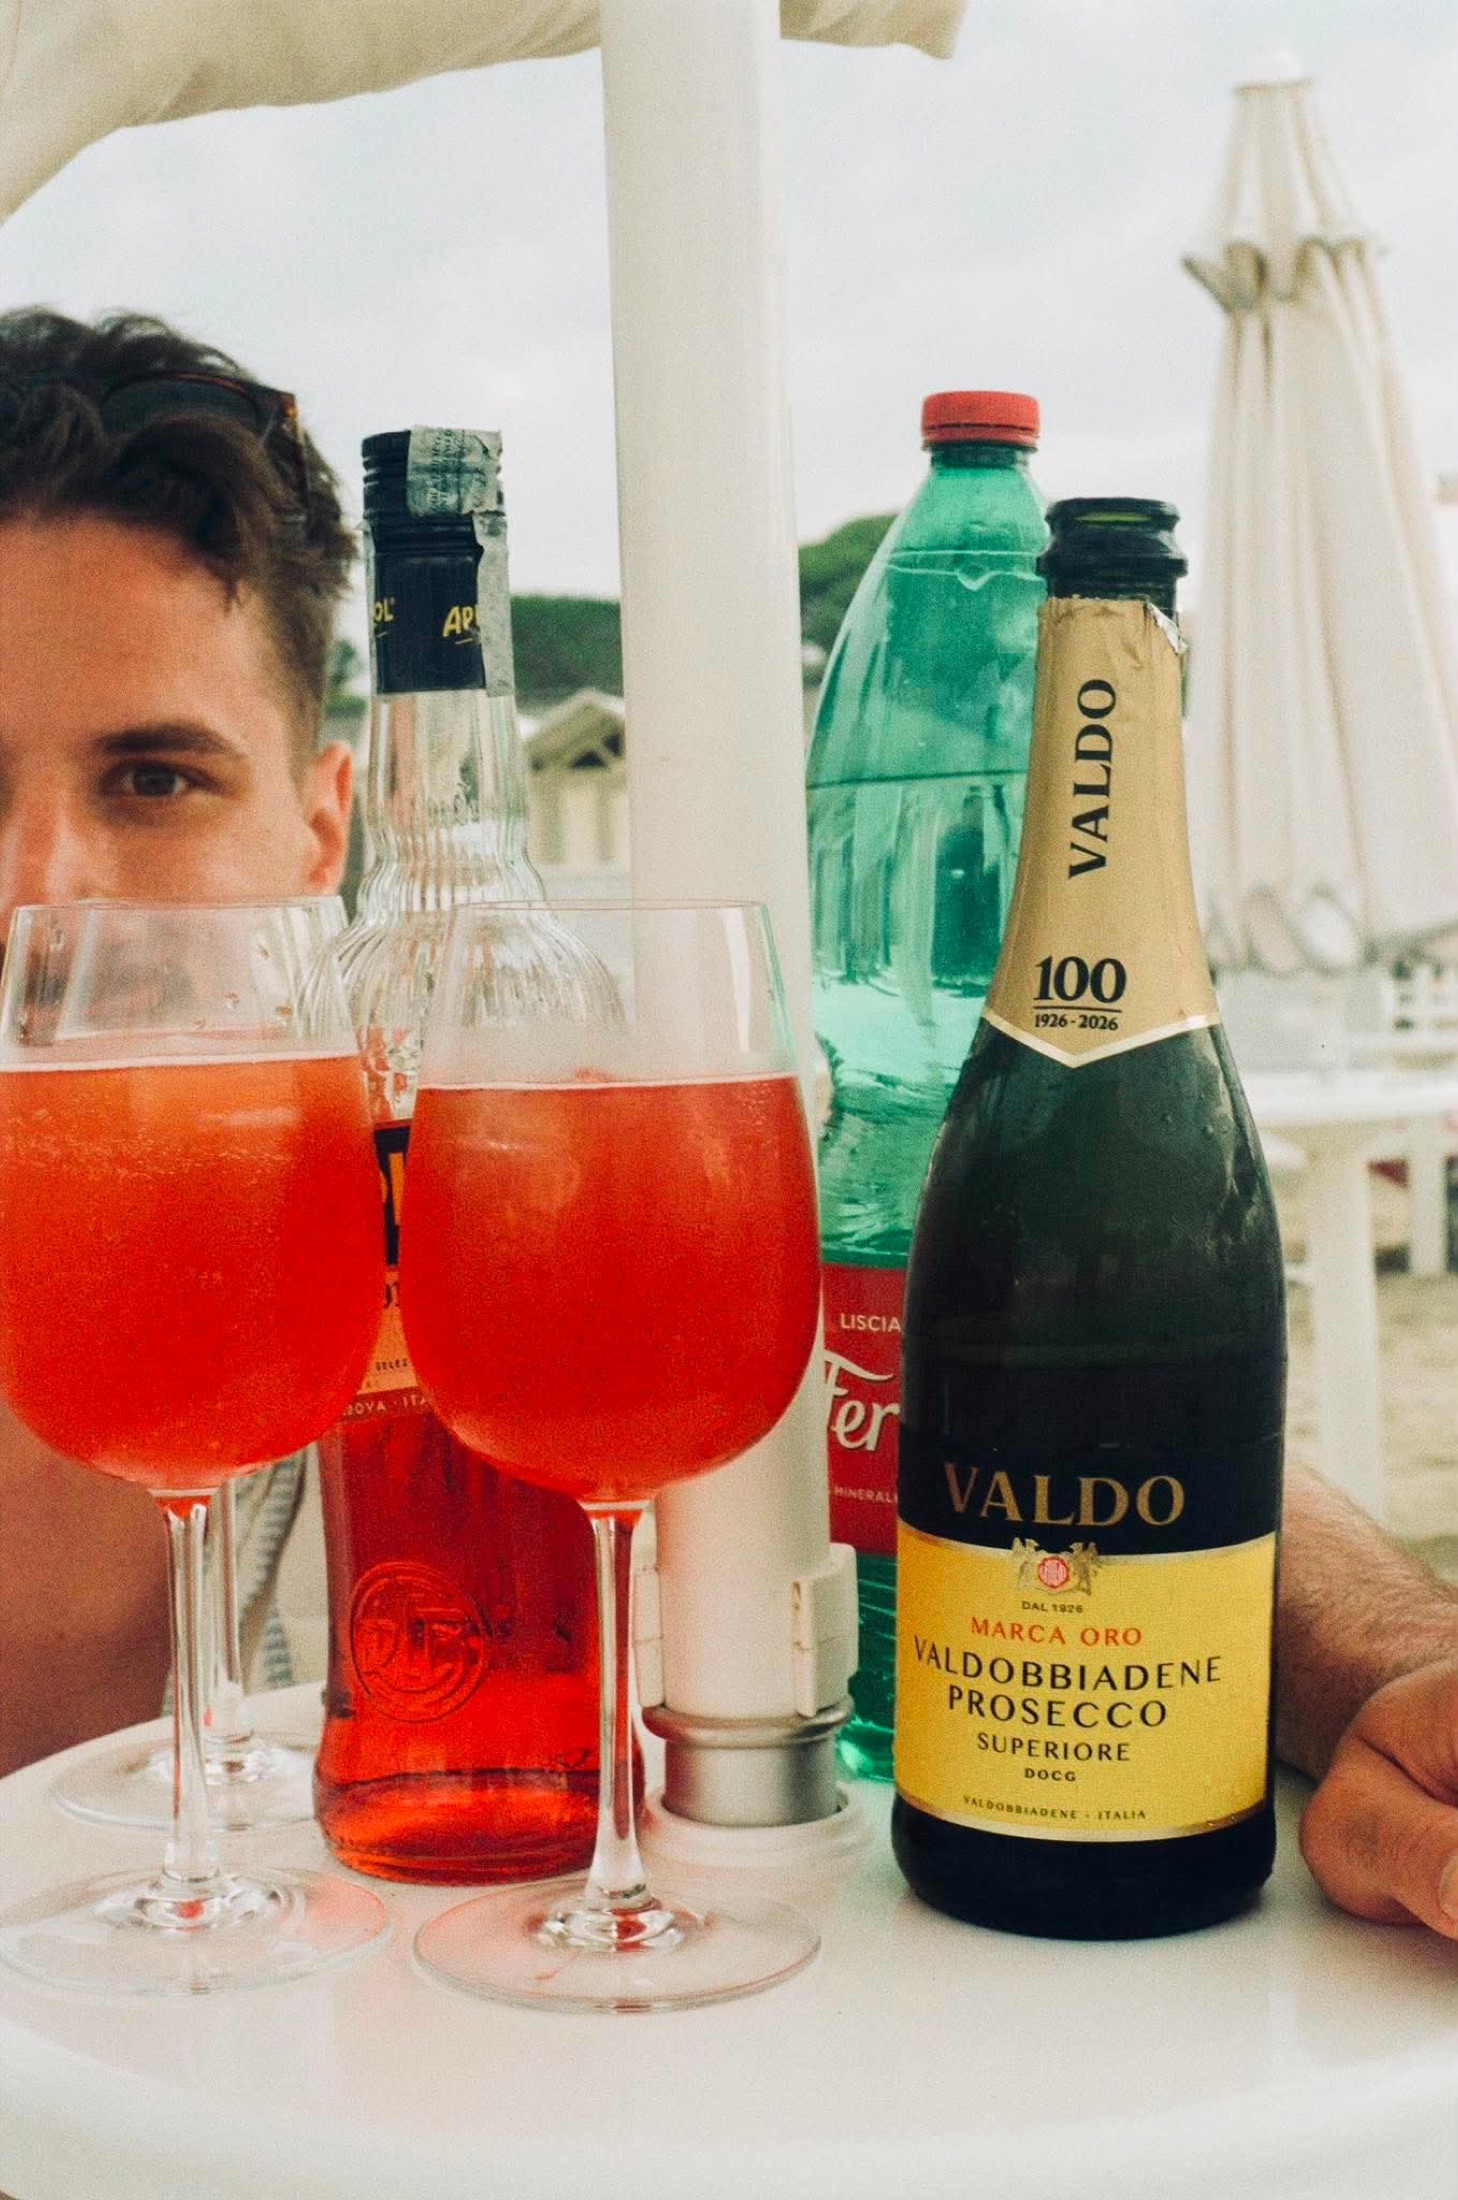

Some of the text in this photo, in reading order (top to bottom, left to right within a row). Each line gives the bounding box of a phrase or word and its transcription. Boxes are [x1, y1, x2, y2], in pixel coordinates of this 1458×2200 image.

[1068, 679, 1117, 879] VALDO
[1033, 955, 1126, 1003] 100
[841, 1313, 901, 1332] LISCIA
[945, 1462, 1185, 1527] VALDO
[1021, 1600, 1083, 1614] DAL 1926
[971, 1616, 1143, 1647] MARCA ORO
[914, 1634, 1221, 1691] VALDOBBIADENE
[949, 1684, 1167, 1728] PROSECCO
[977, 1732, 1131, 1761] SUPERIORE
[1024, 1767, 1077, 1782] DOCG
[963, 1795, 1077, 1820] VALDOBBIADENE
[1098, 1810, 1147, 1821] ITALIA
